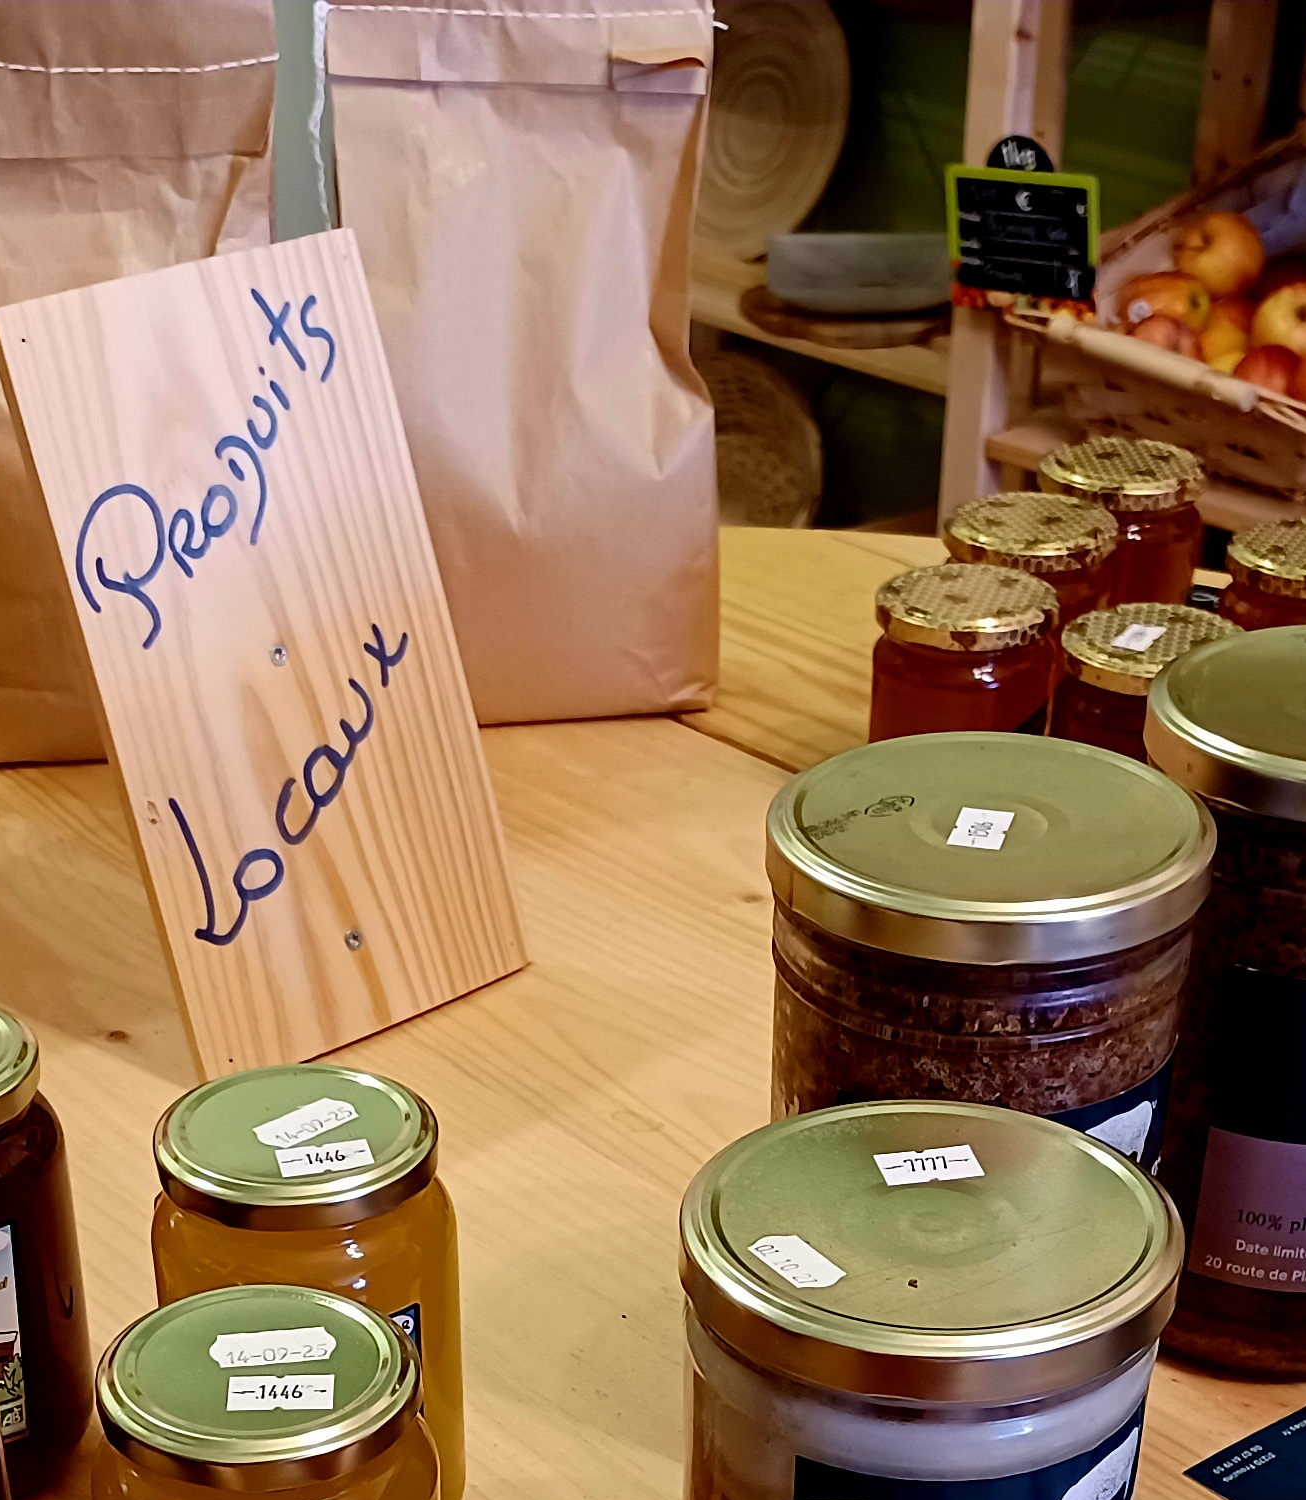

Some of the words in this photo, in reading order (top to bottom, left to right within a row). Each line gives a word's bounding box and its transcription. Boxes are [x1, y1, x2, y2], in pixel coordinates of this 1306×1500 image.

[75, 286, 338, 650] Produits
[193, 622, 410, 947] Locaux
[306, 1150, 346, 1165] 1446
[1226, 1260, 1264, 1279] route
[256, 1384, 303, 1399] 1446
